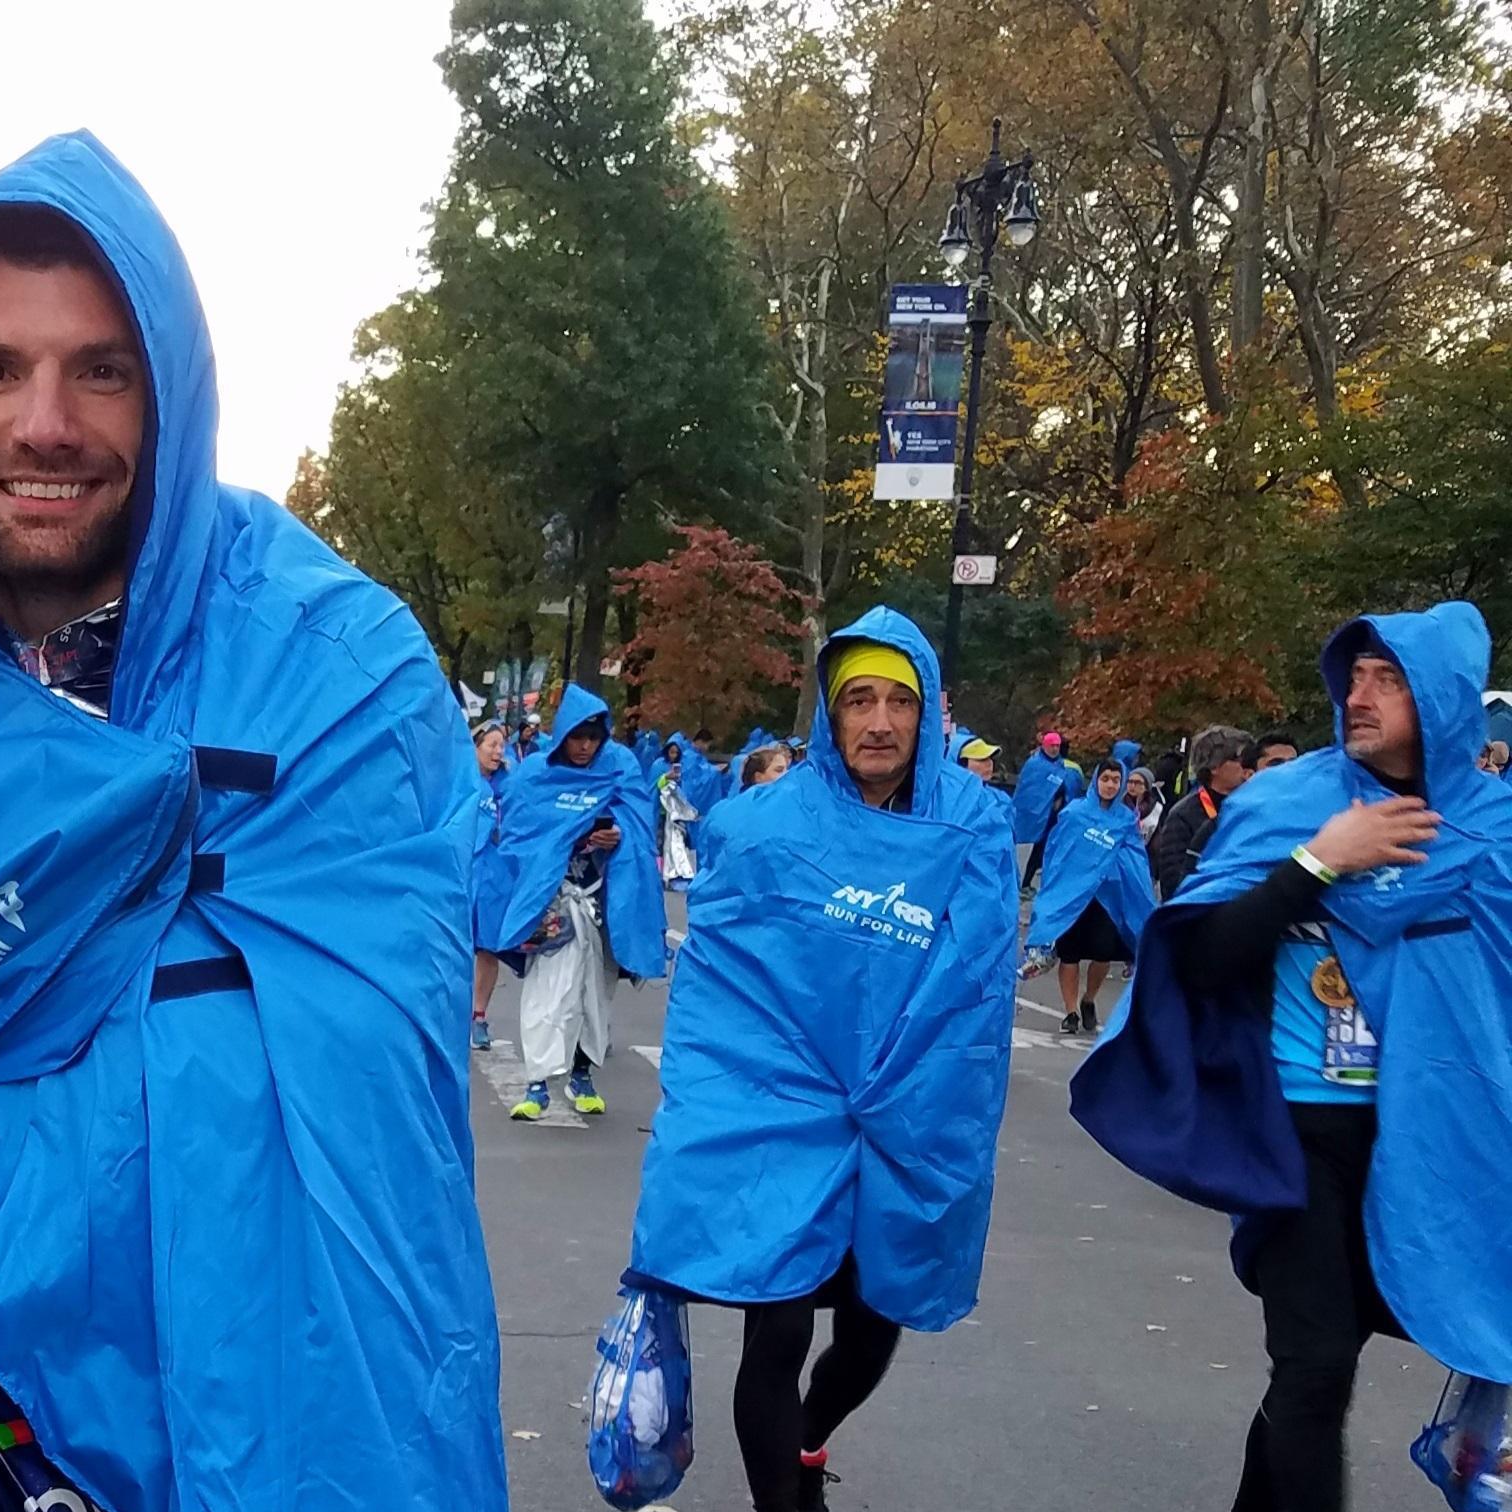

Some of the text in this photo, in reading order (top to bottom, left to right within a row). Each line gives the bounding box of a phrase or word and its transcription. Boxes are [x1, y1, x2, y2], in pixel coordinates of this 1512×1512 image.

[824, 903, 931, 950] RUN FOR LIFE
